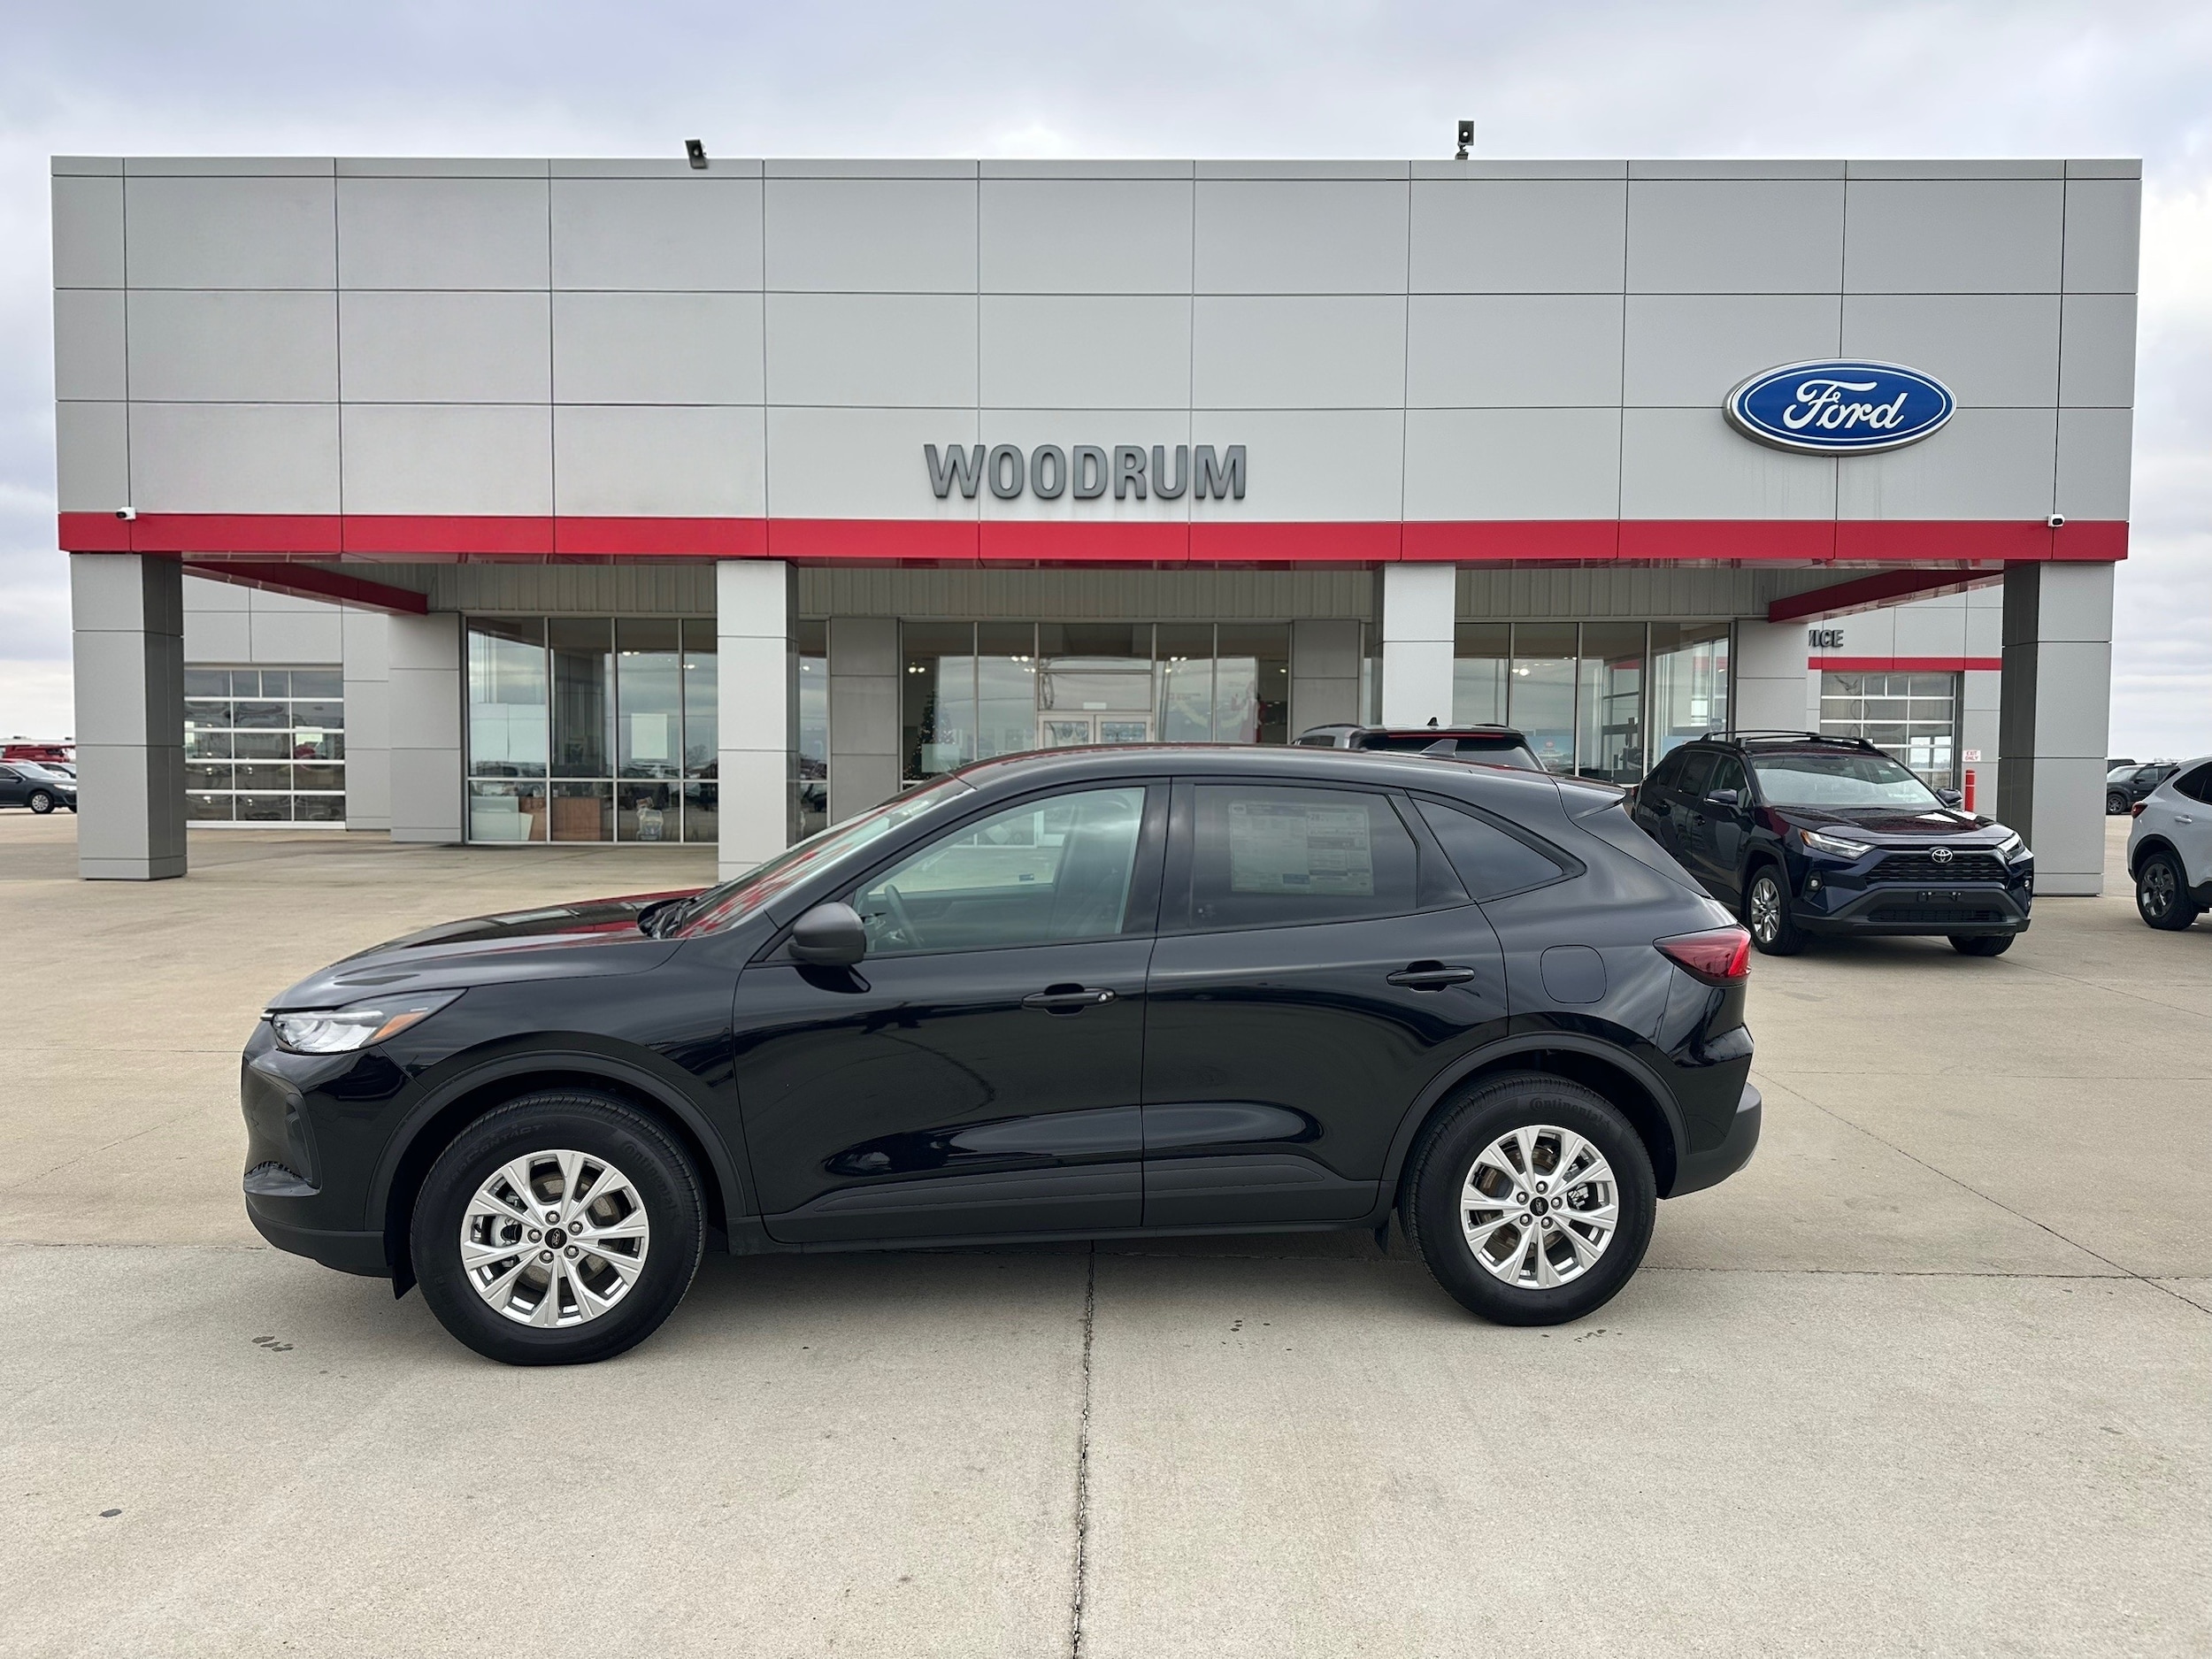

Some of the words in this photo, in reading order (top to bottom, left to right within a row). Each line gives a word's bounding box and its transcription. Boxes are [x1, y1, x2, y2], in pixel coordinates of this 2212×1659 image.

[1782, 379, 1909, 430] Ford
[923, 443, 1247, 500] WOODRUM
[1528, 1097, 1603, 1123] Continental
